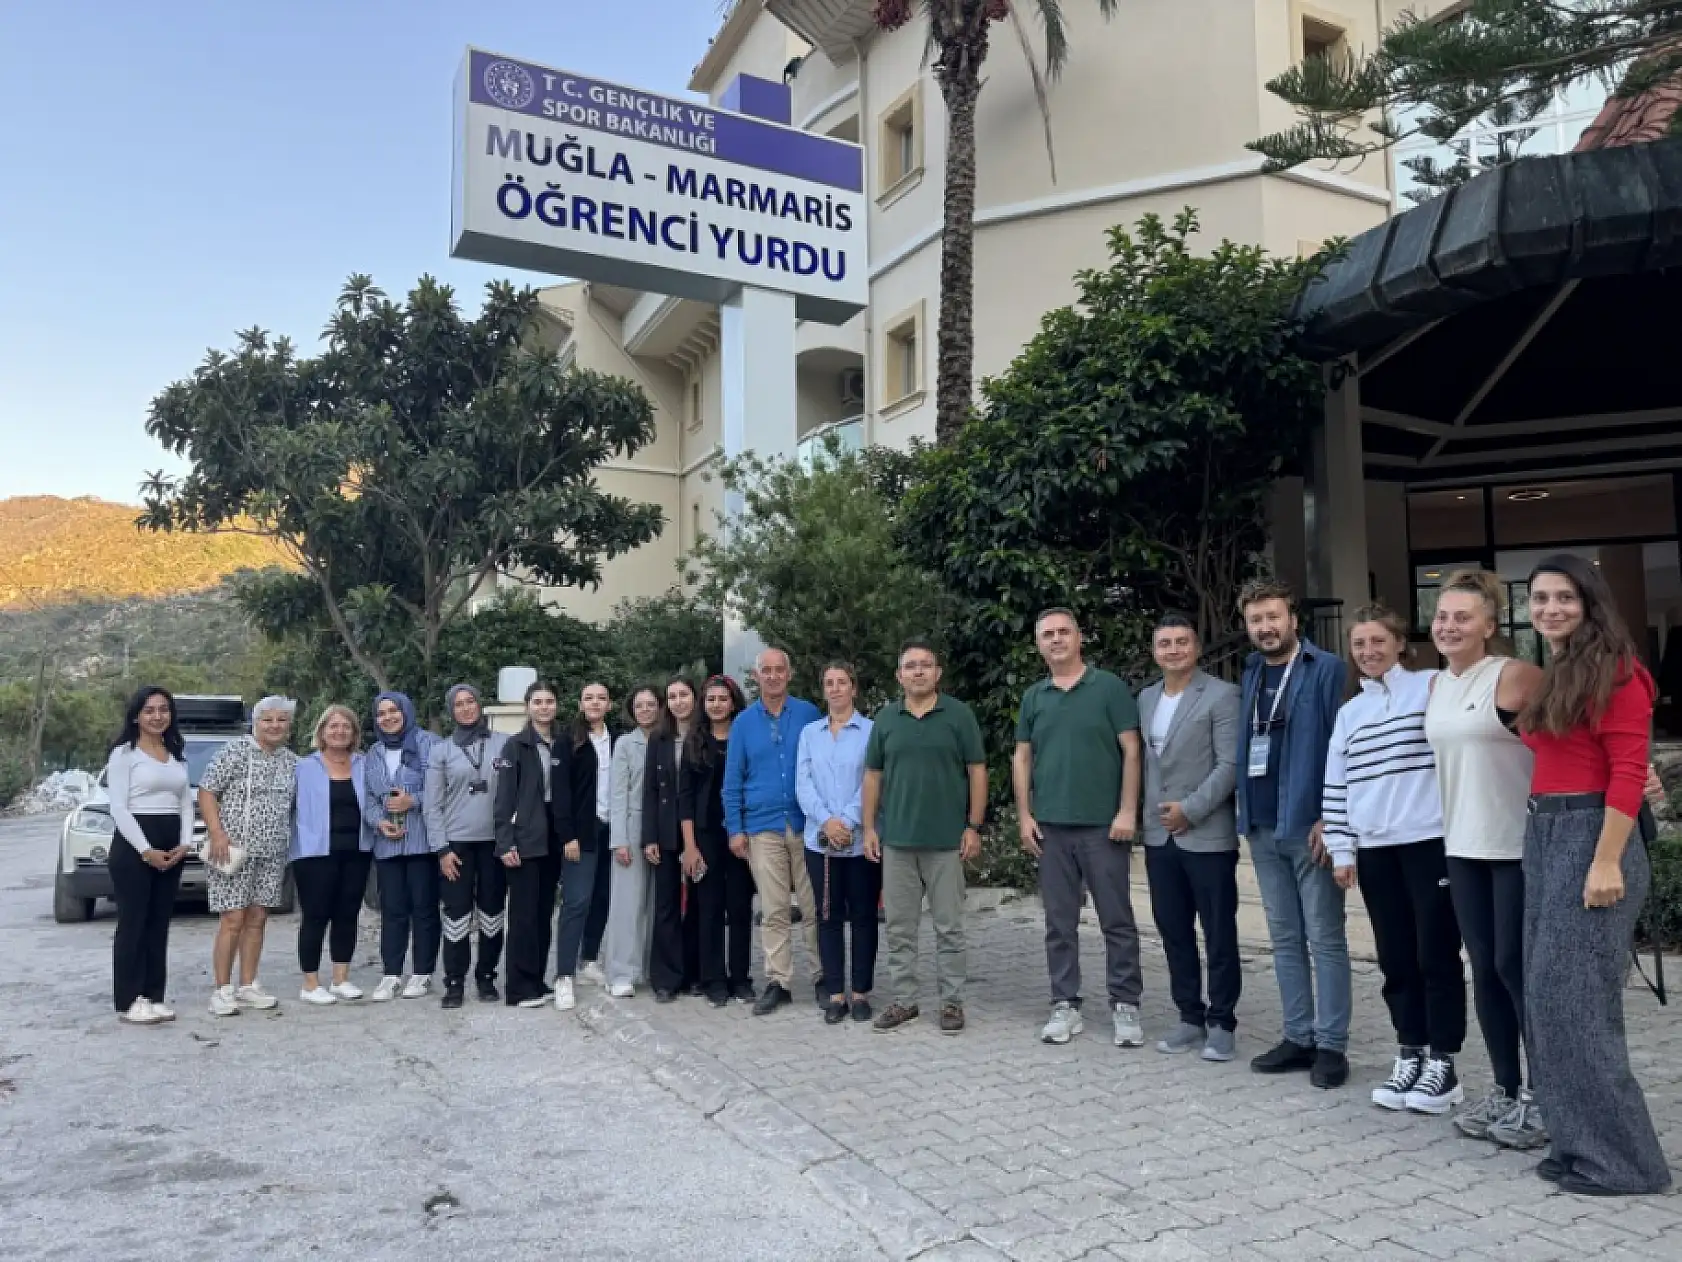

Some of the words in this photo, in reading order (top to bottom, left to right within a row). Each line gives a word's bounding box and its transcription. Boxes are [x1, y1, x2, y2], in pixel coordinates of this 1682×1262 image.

[543, 98, 601, 126] SPOR
[606, 112, 716, 153] BAKANLIĞI
[589, 86, 683, 122] GENÇLİK
[688, 109, 715, 130] VE
[486, 124, 635, 185] MUĞLA
[667, 164, 852, 232] MARMARİS
[497, 172, 700, 254] ÖĞRENCİ
[709, 223, 846, 282] YURDU
